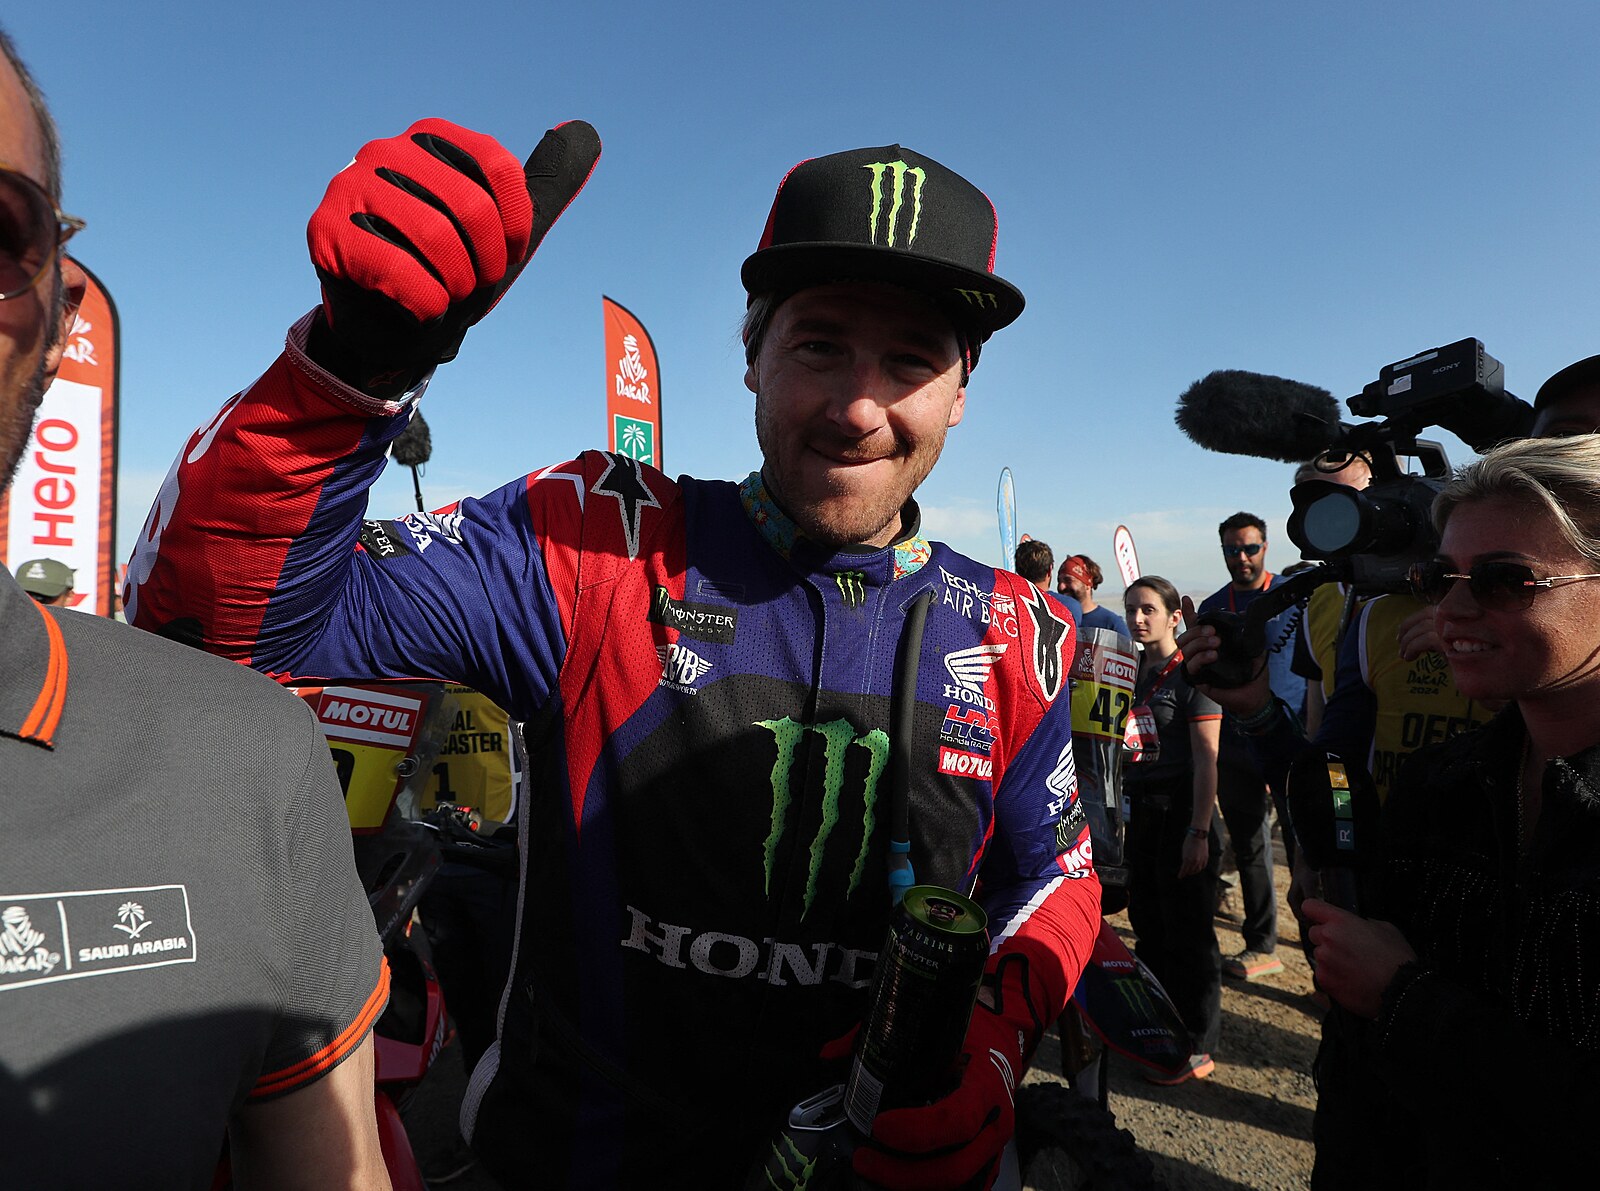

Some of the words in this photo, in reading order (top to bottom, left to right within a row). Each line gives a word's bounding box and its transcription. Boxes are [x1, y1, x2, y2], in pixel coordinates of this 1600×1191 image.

[1433, 361, 1460, 375] SONY
[616, 374, 651, 404] DAKAR
[32, 418, 79, 546] Hero
[365, 520, 395, 556] STER
[669, 602, 734, 628] MONSTER
[943, 586, 972, 619] AIR
[981, 602, 1019, 638] BAG
[1105, 661, 1136, 681] MOTU
[1407, 670, 1448, 688] DAKAR
[1409, 686, 1440, 695] 2024
[321, 700, 412, 733] MOTUL
[1089, 688, 1130, 736] 42
[79, 944, 129, 962] SAUDI
[132, 937, 187, 956] ARABIA
[620, 905, 879, 989] HOND
[903, 922, 953, 953] TAURINE
